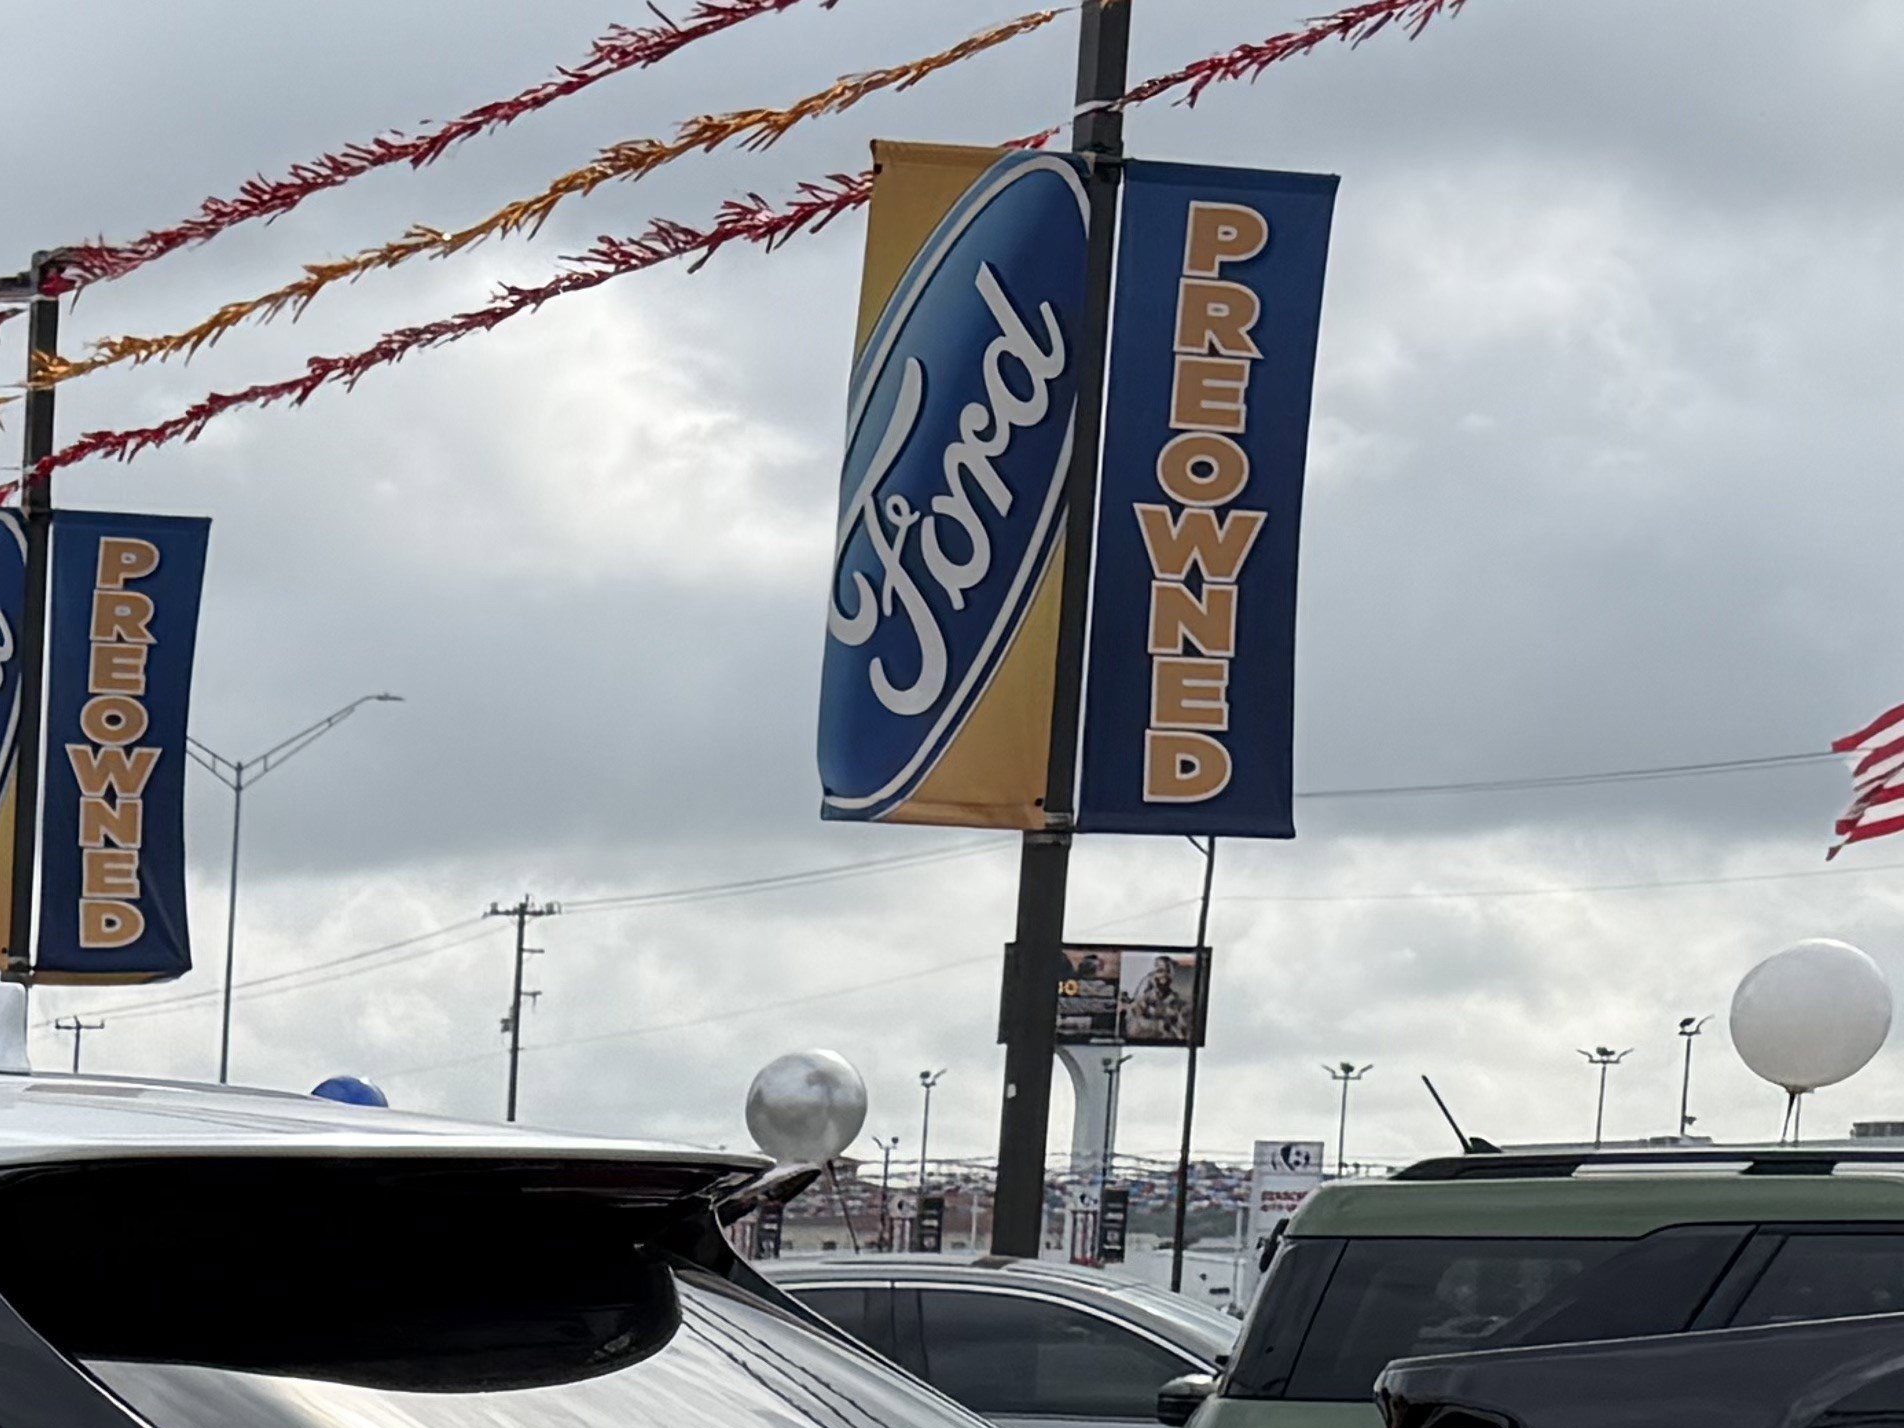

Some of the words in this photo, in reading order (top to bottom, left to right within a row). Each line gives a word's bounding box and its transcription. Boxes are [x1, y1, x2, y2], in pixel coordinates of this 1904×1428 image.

[827, 261, 1067, 717] Ford
[1133, 199, 1269, 804] PREOWNED
[64, 535, 163, 949] PREOWNED
